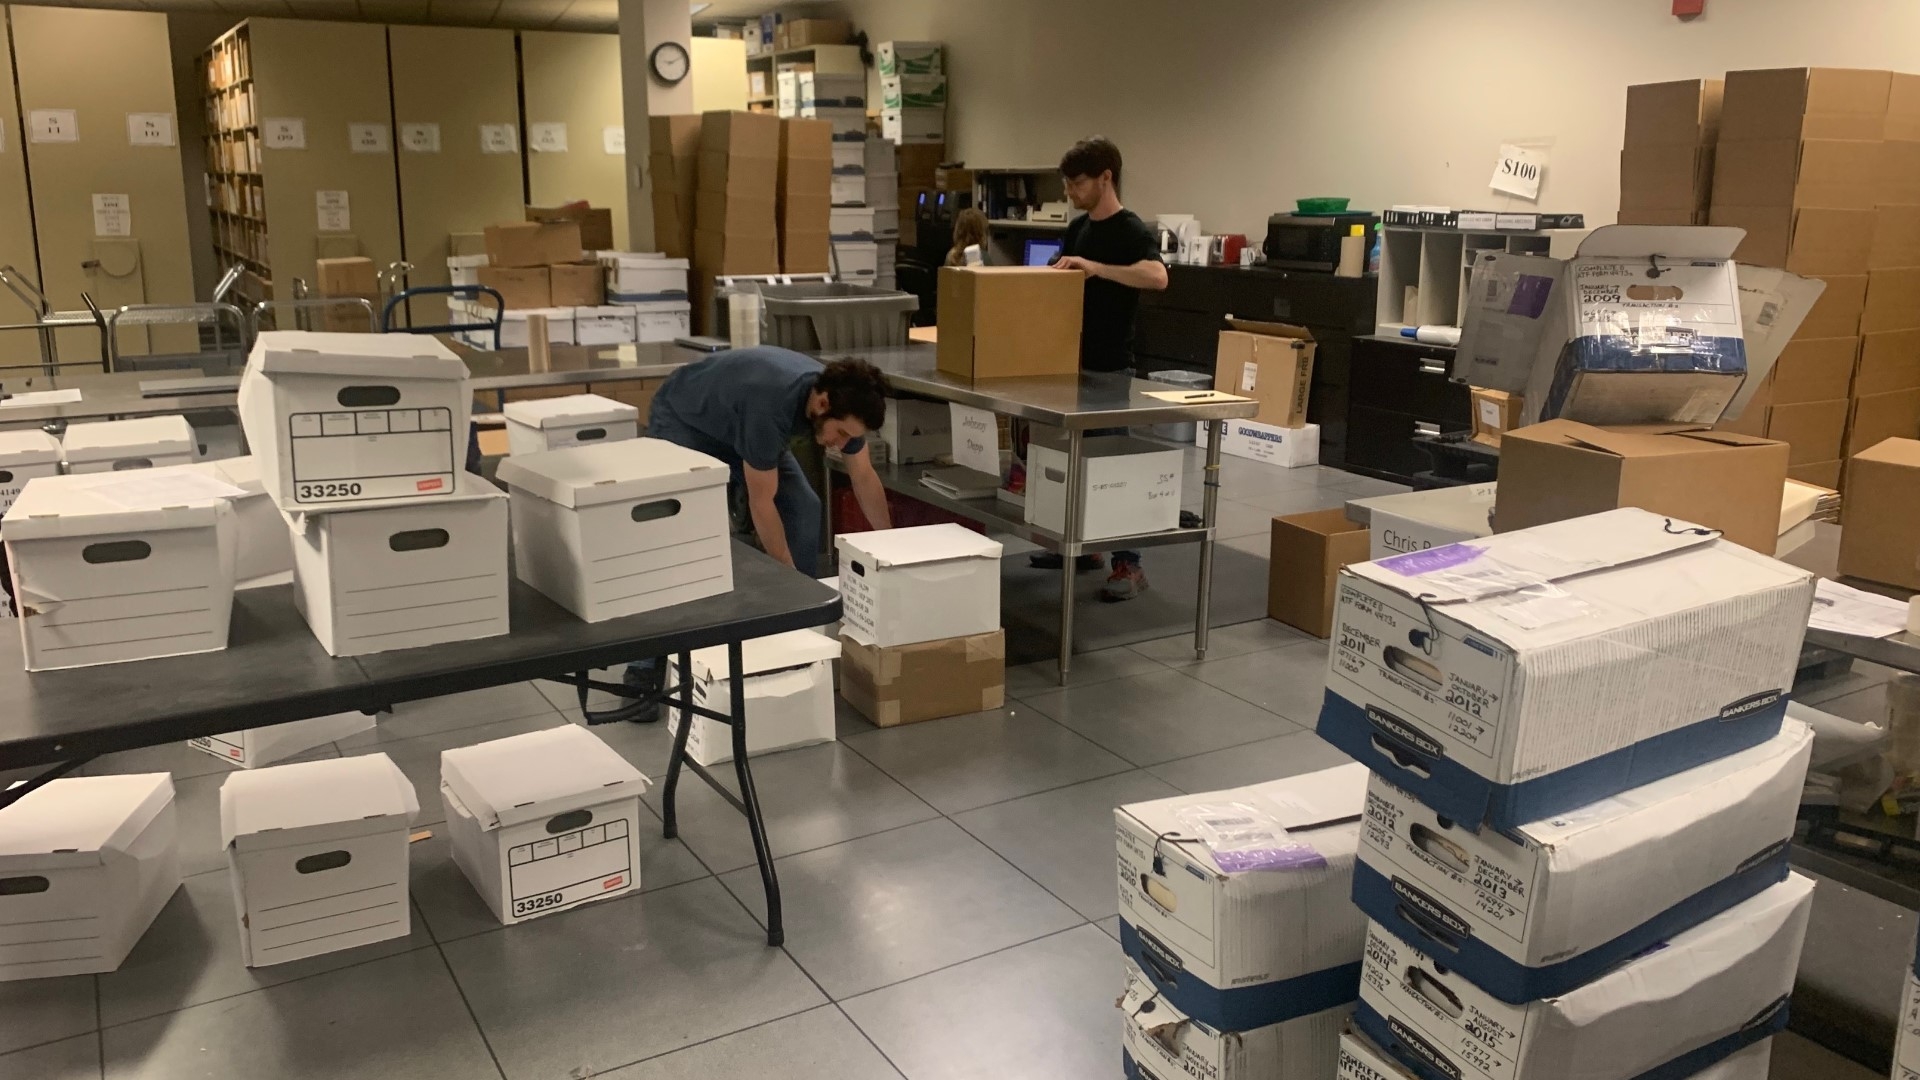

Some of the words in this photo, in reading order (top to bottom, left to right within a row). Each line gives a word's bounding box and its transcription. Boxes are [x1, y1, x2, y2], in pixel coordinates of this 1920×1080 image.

[1502, 158, 1537, 180] S100
[1583, 294, 1621, 303] 2009
[1296, 379, 1307, 414] LARGE
[300, 482, 362, 498] 33250
[1383, 529, 1418, 552] Chris
[1341, 595, 1353, 604] ATF
[1355, 601, 1372, 615] FORM
[1341, 634, 1365, 654] 2011
[1342, 622, 1380, 648] DECEMBER
[1448, 672, 1488, 697] JANUARY
[1451, 683, 1490, 709] OCTOBER
[1445, 690, 1482, 718] 2012
[1722, 700, 1761, 718] BANKERS
[1761, 695, 1778, 706] BOX
[1368, 710, 1415, 742] BANKERS
[1416, 737, 1439, 755] BOX
[1448, 711, 1472, 729] 11001
[1448, 723, 1478, 744] 12204
[1367, 804, 1395, 831] 2012
[1474, 854, 1512, 880] JANUARY
[1473, 873, 1507, 899] 2013
[1477, 866, 1525, 898] DECEMBER
[516, 892, 563, 913] 33250
[1394, 882, 1441, 918] BANKERS
[1442, 913, 1467, 934] BOX
[1476, 900, 1505, 920] 14201
[1165, 953, 1180, 969] BOX
[1367, 944, 1390, 970] 2014
[1468, 1004, 1505, 1032] JANUARY
[1473, 1017, 1504, 1038] AUGUST
[1465, 1019, 1503, 1048] 2015
[1390, 1022, 1435, 1061] BANKERS
[1435, 1057, 1458, 1079] BOX
[1461, 1038, 1491, 1060] 15377
[1340, 1050, 1387, 1080] COMPLET
